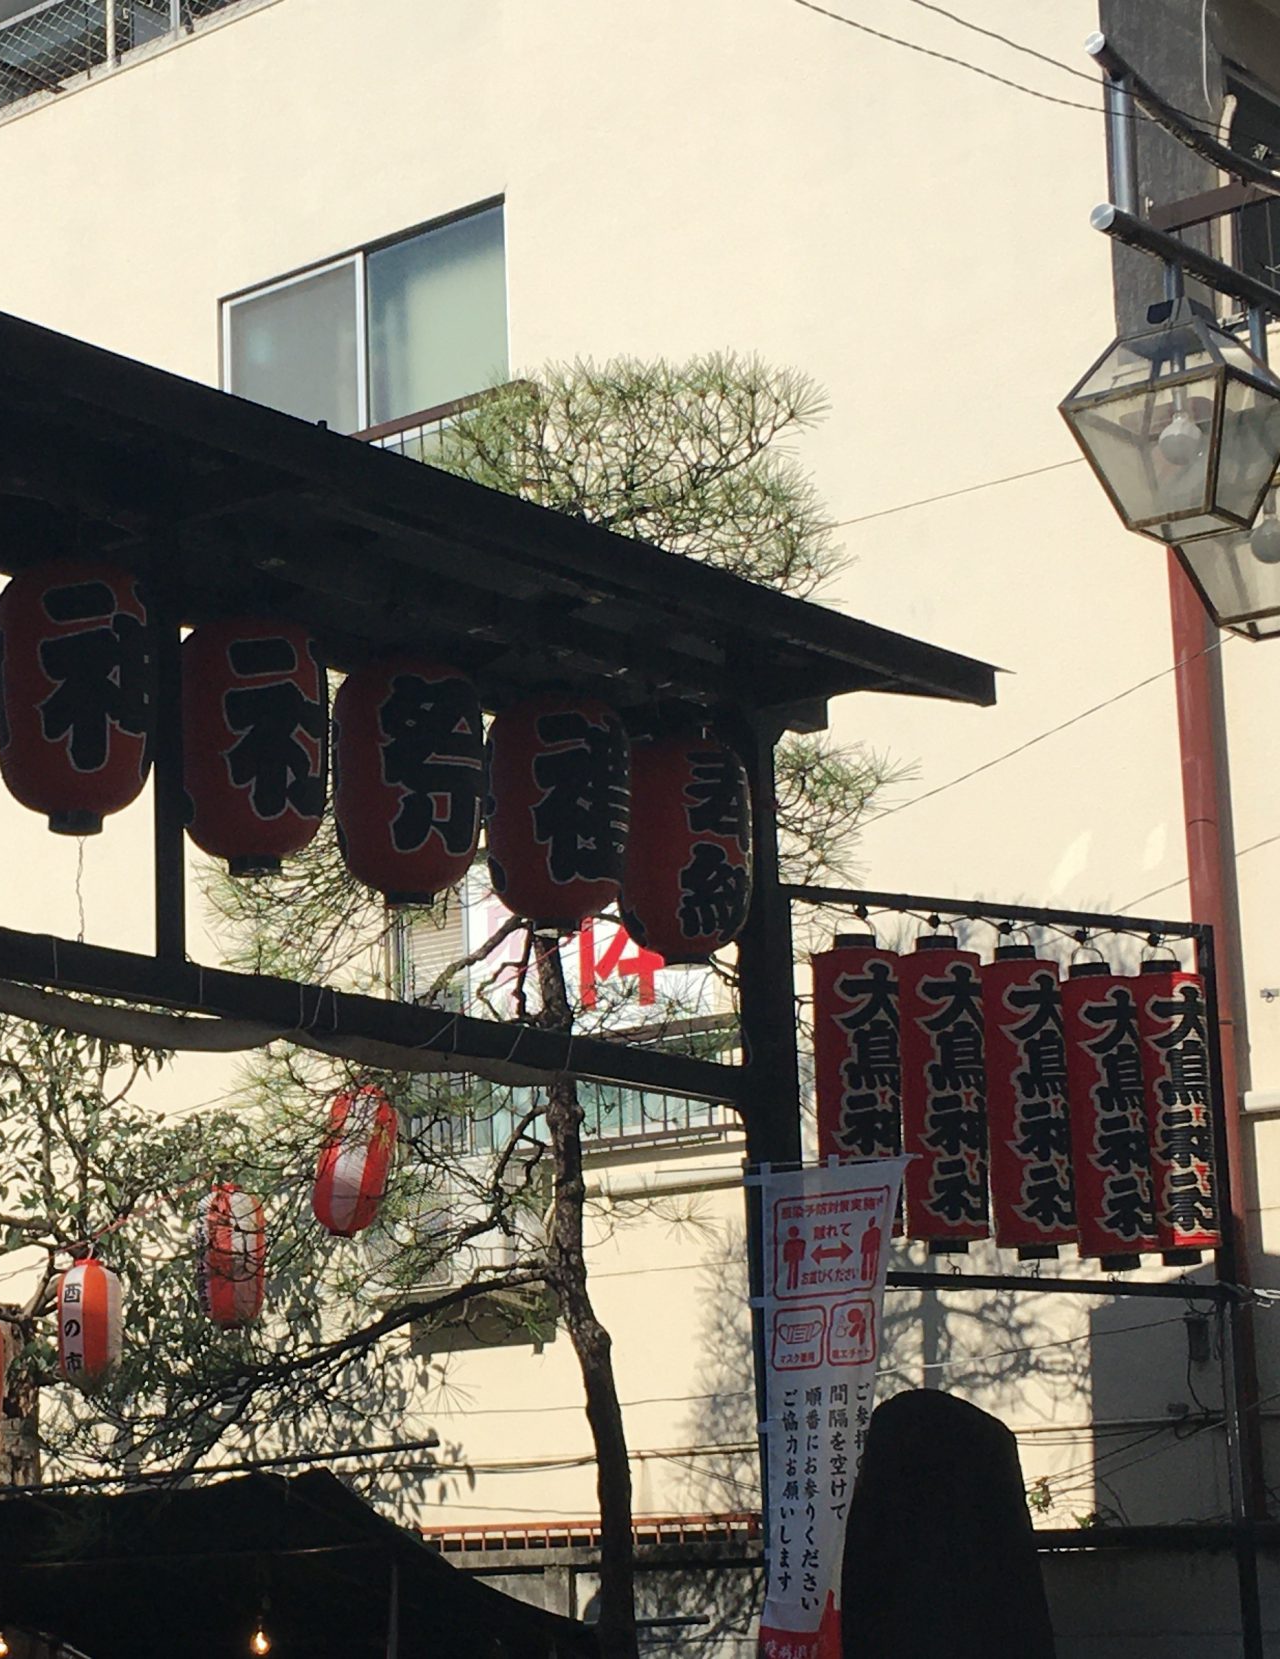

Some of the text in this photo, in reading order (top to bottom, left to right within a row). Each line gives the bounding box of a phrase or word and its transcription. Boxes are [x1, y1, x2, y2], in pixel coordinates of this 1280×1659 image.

[832, 958, 904, 1158] 大鳥神
[916, 962, 989, 1226] 大鳥神社
[1001, 970, 1076, 1232] 大鳥神社
[1080, 986, 1159, 1241] 大鳥神社
[1146, 982, 1218, 1240] 大鳥神社
[62, 1281, 84, 1373] 酉の市
[814, 1222, 853, 1241] 離れて
[776, 1388, 799, 1592] ご協力お願いします
[801, 1386, 822, 1610] 順番にお参りください
[828, 1384, 849, 1521] 間隔を空けて
